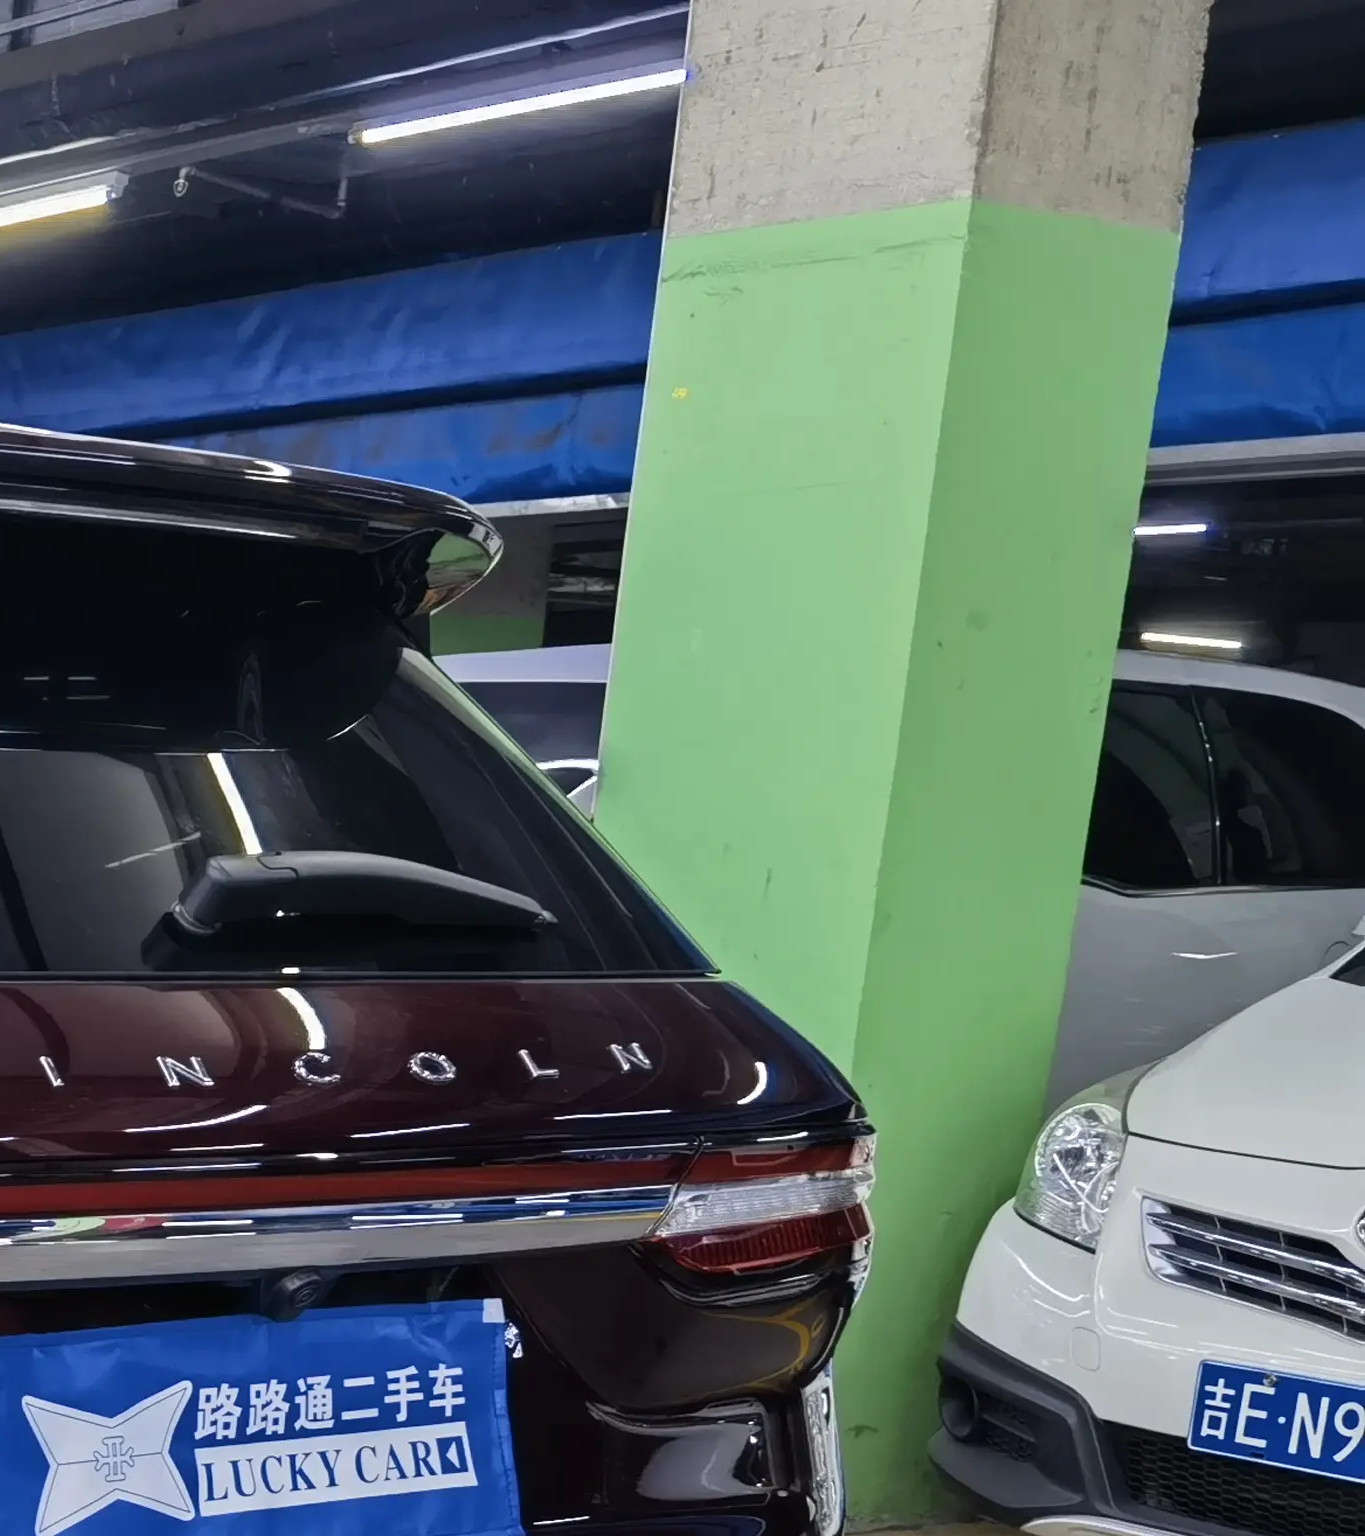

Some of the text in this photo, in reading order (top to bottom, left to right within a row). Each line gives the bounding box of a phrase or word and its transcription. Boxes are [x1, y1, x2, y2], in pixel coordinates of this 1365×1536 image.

[194, 1363, 467, 1441] 路路通二手车
[201, 1438, 439, 1503] LUCKY CAR
